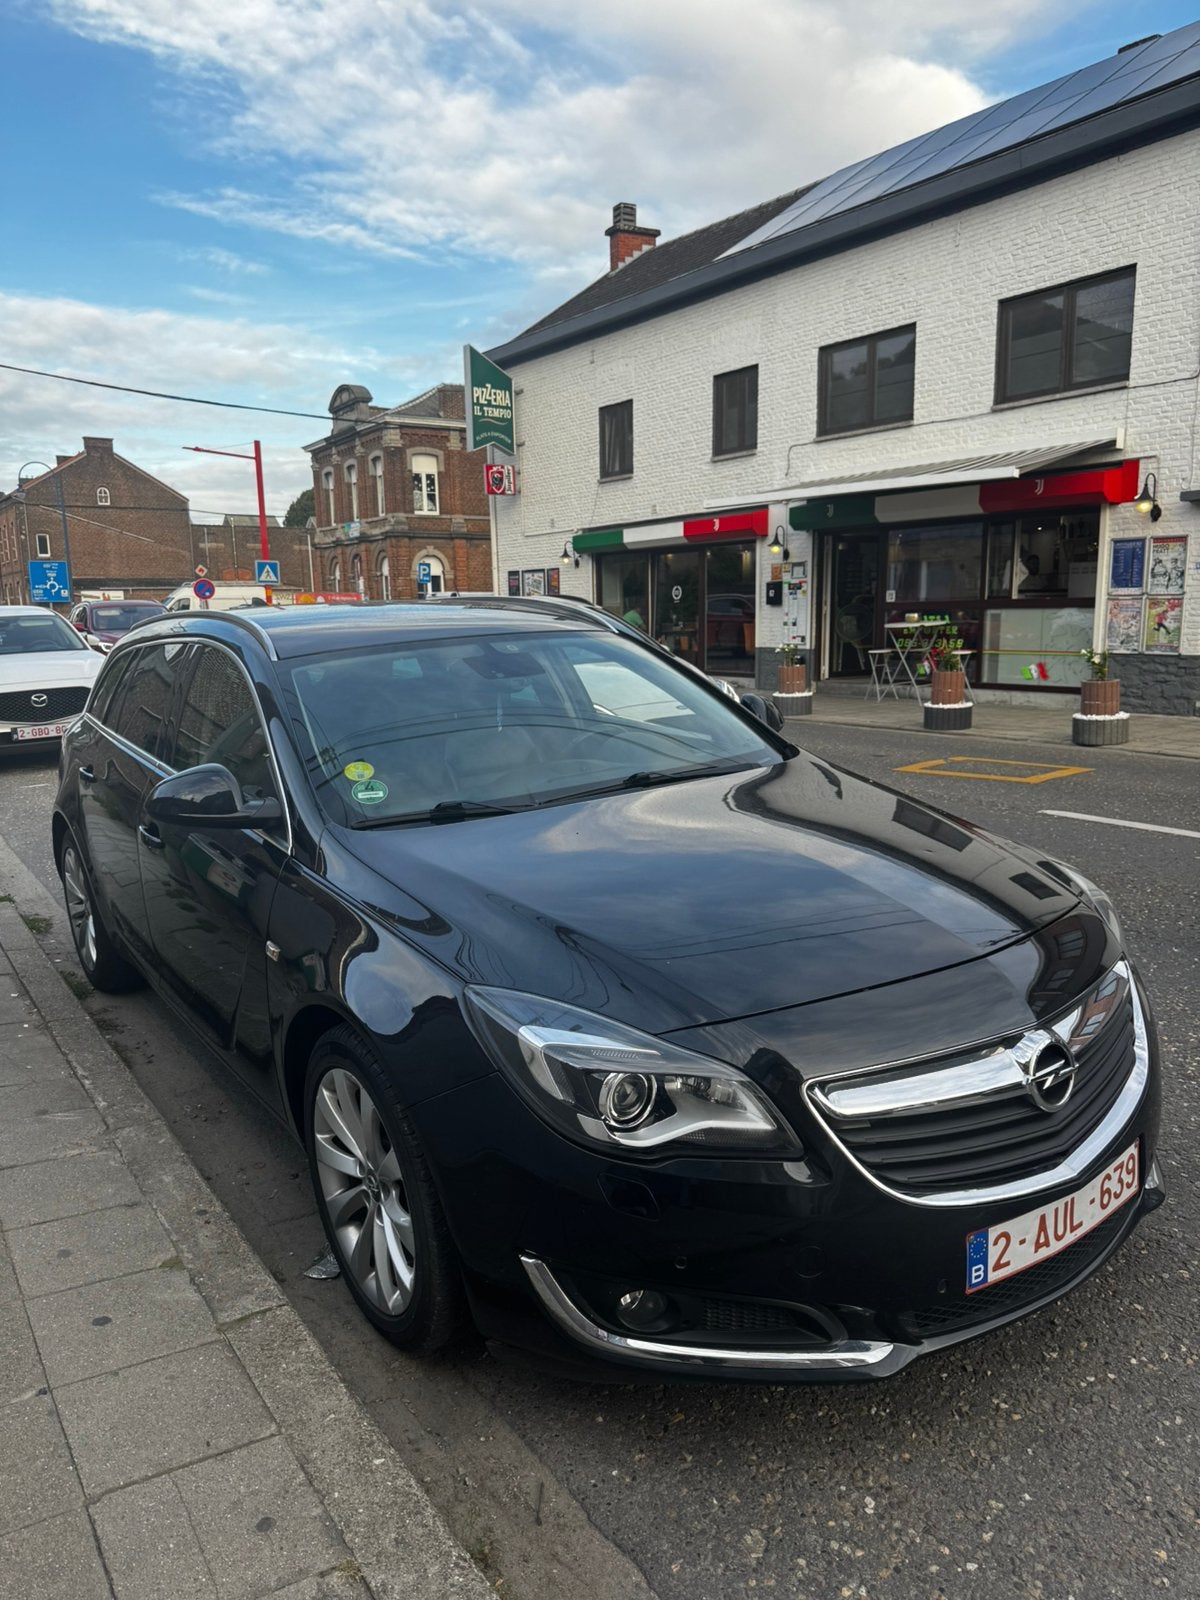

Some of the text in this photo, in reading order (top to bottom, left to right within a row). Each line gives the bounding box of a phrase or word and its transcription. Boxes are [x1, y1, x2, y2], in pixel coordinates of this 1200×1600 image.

[473, 383, 511, 407] PIZZERIA
[474, 405, 512, 419] IL TEMPIO
[992, 1152, 1136, 1273] 2-AUL-639
[971, 1264, 985, 1284] B
